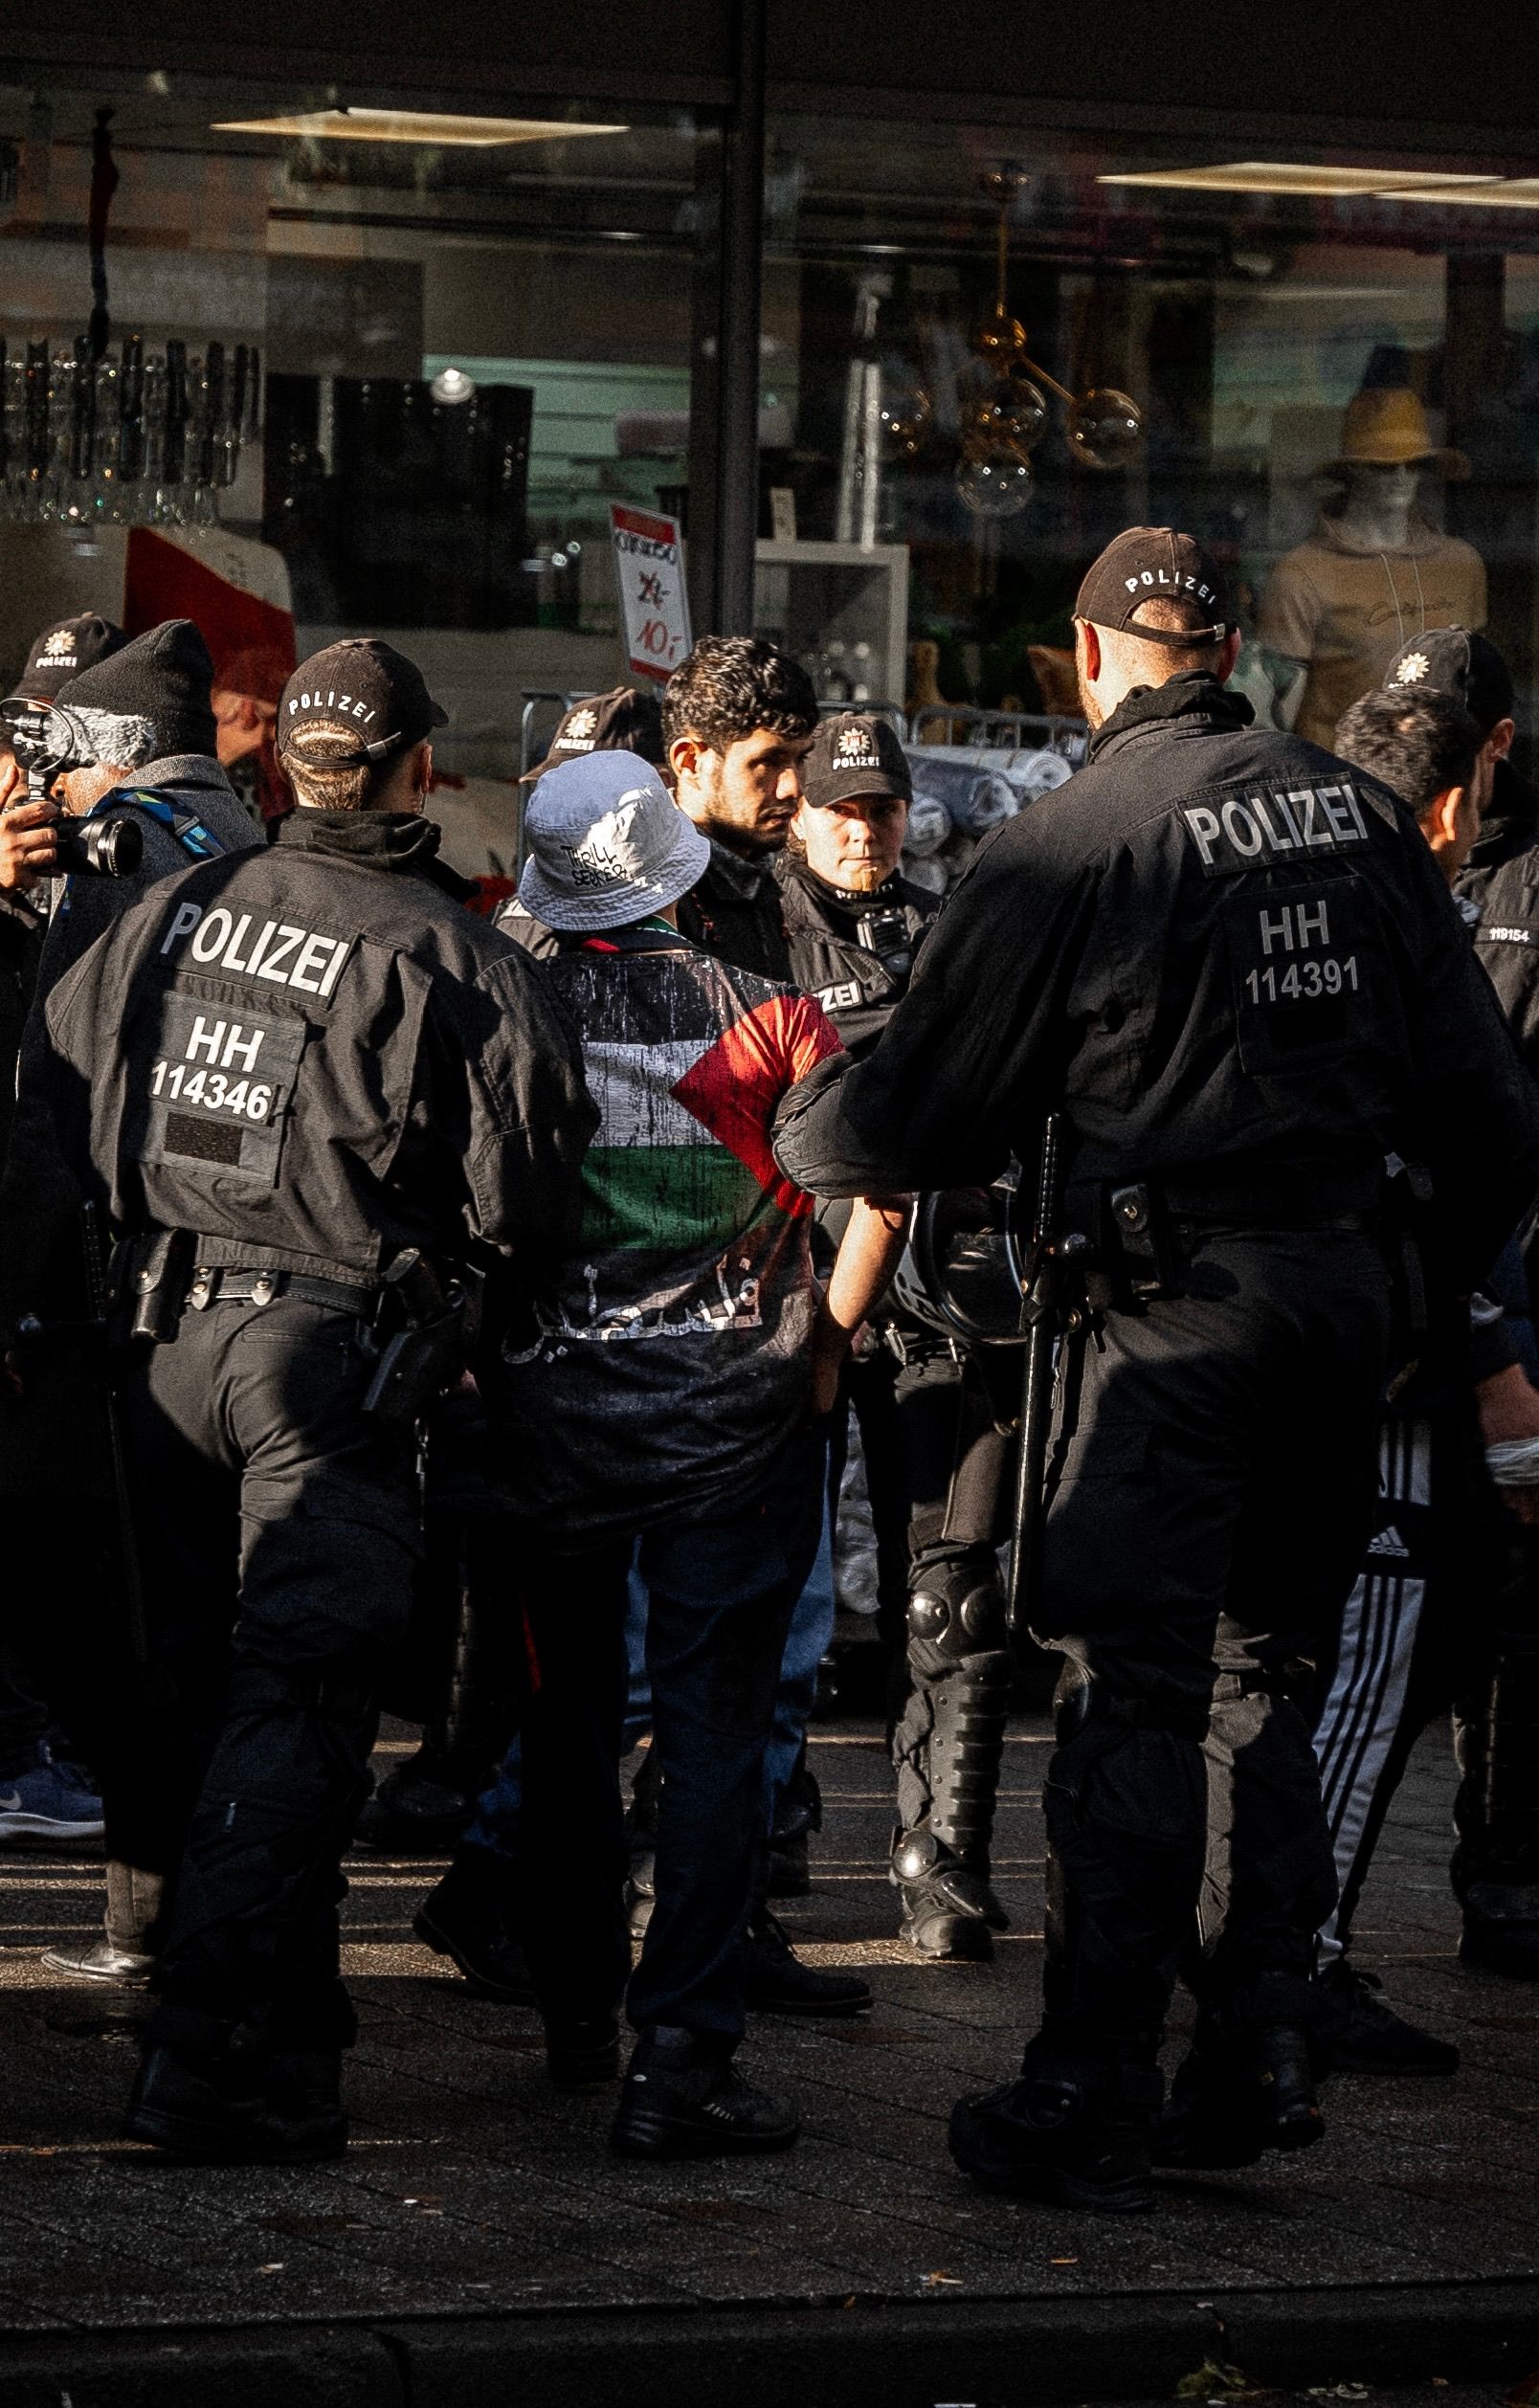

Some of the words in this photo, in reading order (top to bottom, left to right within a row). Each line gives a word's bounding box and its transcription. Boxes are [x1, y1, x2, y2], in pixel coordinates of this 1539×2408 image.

[1125, 569, 1216, 605] POLIZEI
[288, 690, 376, 724] POLIZEI
[832, 755, 880, 770] POLIZEI
[1184, 784, 1369, 865] POLIZEI
[160, 902, 350, 997] POLIZEI
[1259, 900, 1330, 955] HH
[812, 981, 860, 1014] ZEI
[1245, 956, 1358, 1005] 114391
[185, 1015, 265, 1073] HH
[151, 1060, 272, 1120] 114346
